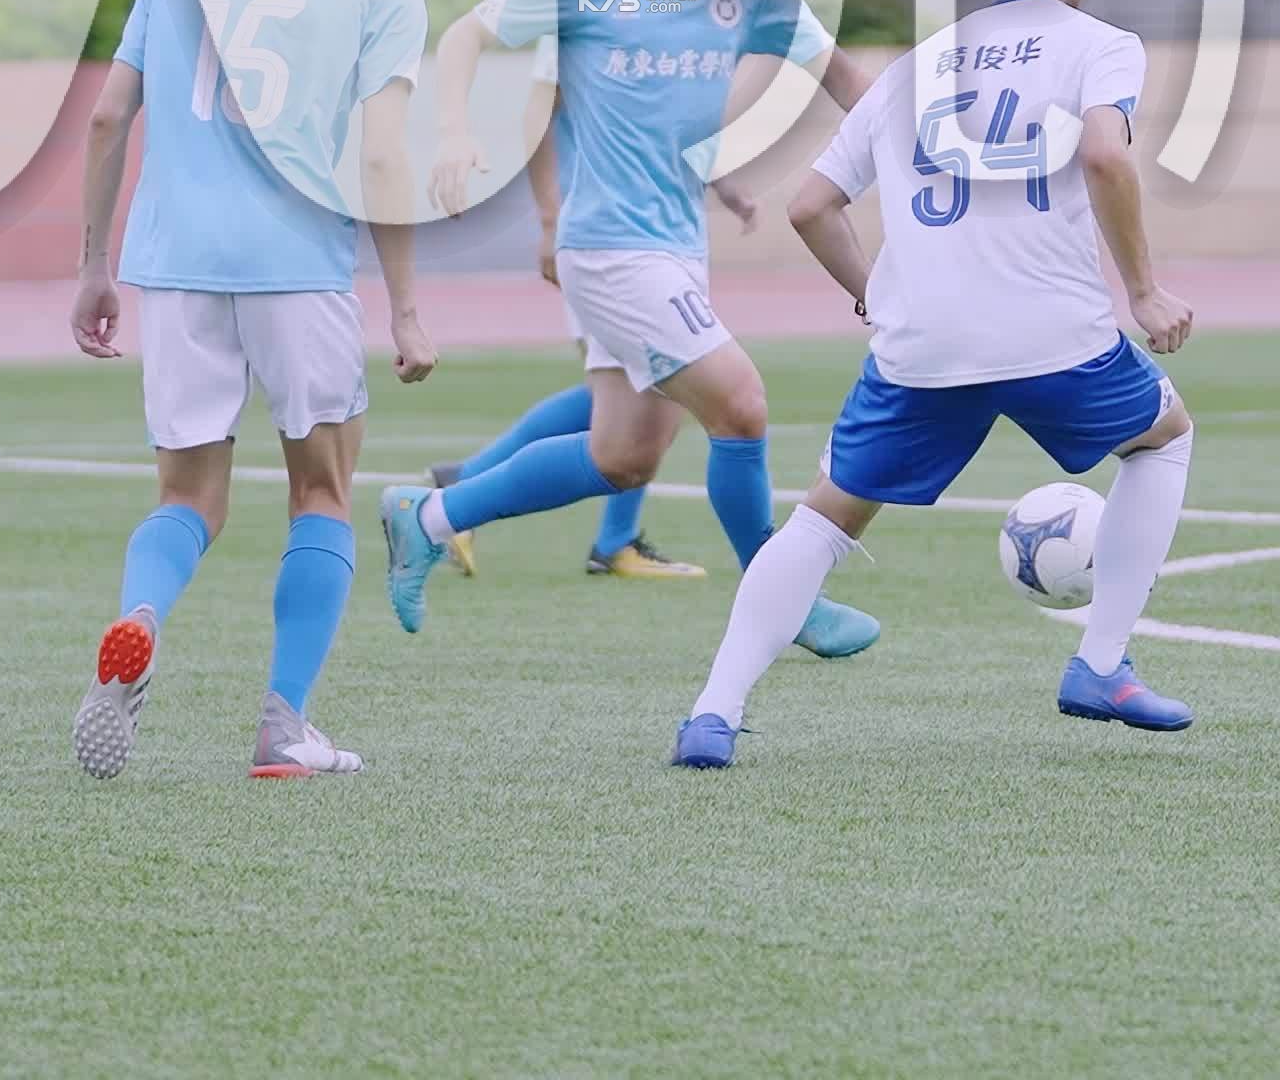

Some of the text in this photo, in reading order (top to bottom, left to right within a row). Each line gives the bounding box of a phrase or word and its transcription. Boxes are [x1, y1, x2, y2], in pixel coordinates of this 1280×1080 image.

[935, 35, 1044, 79] 黄俊华
[911, 87, 1051, 227] 54
[668, 290, 716, 335] 10
